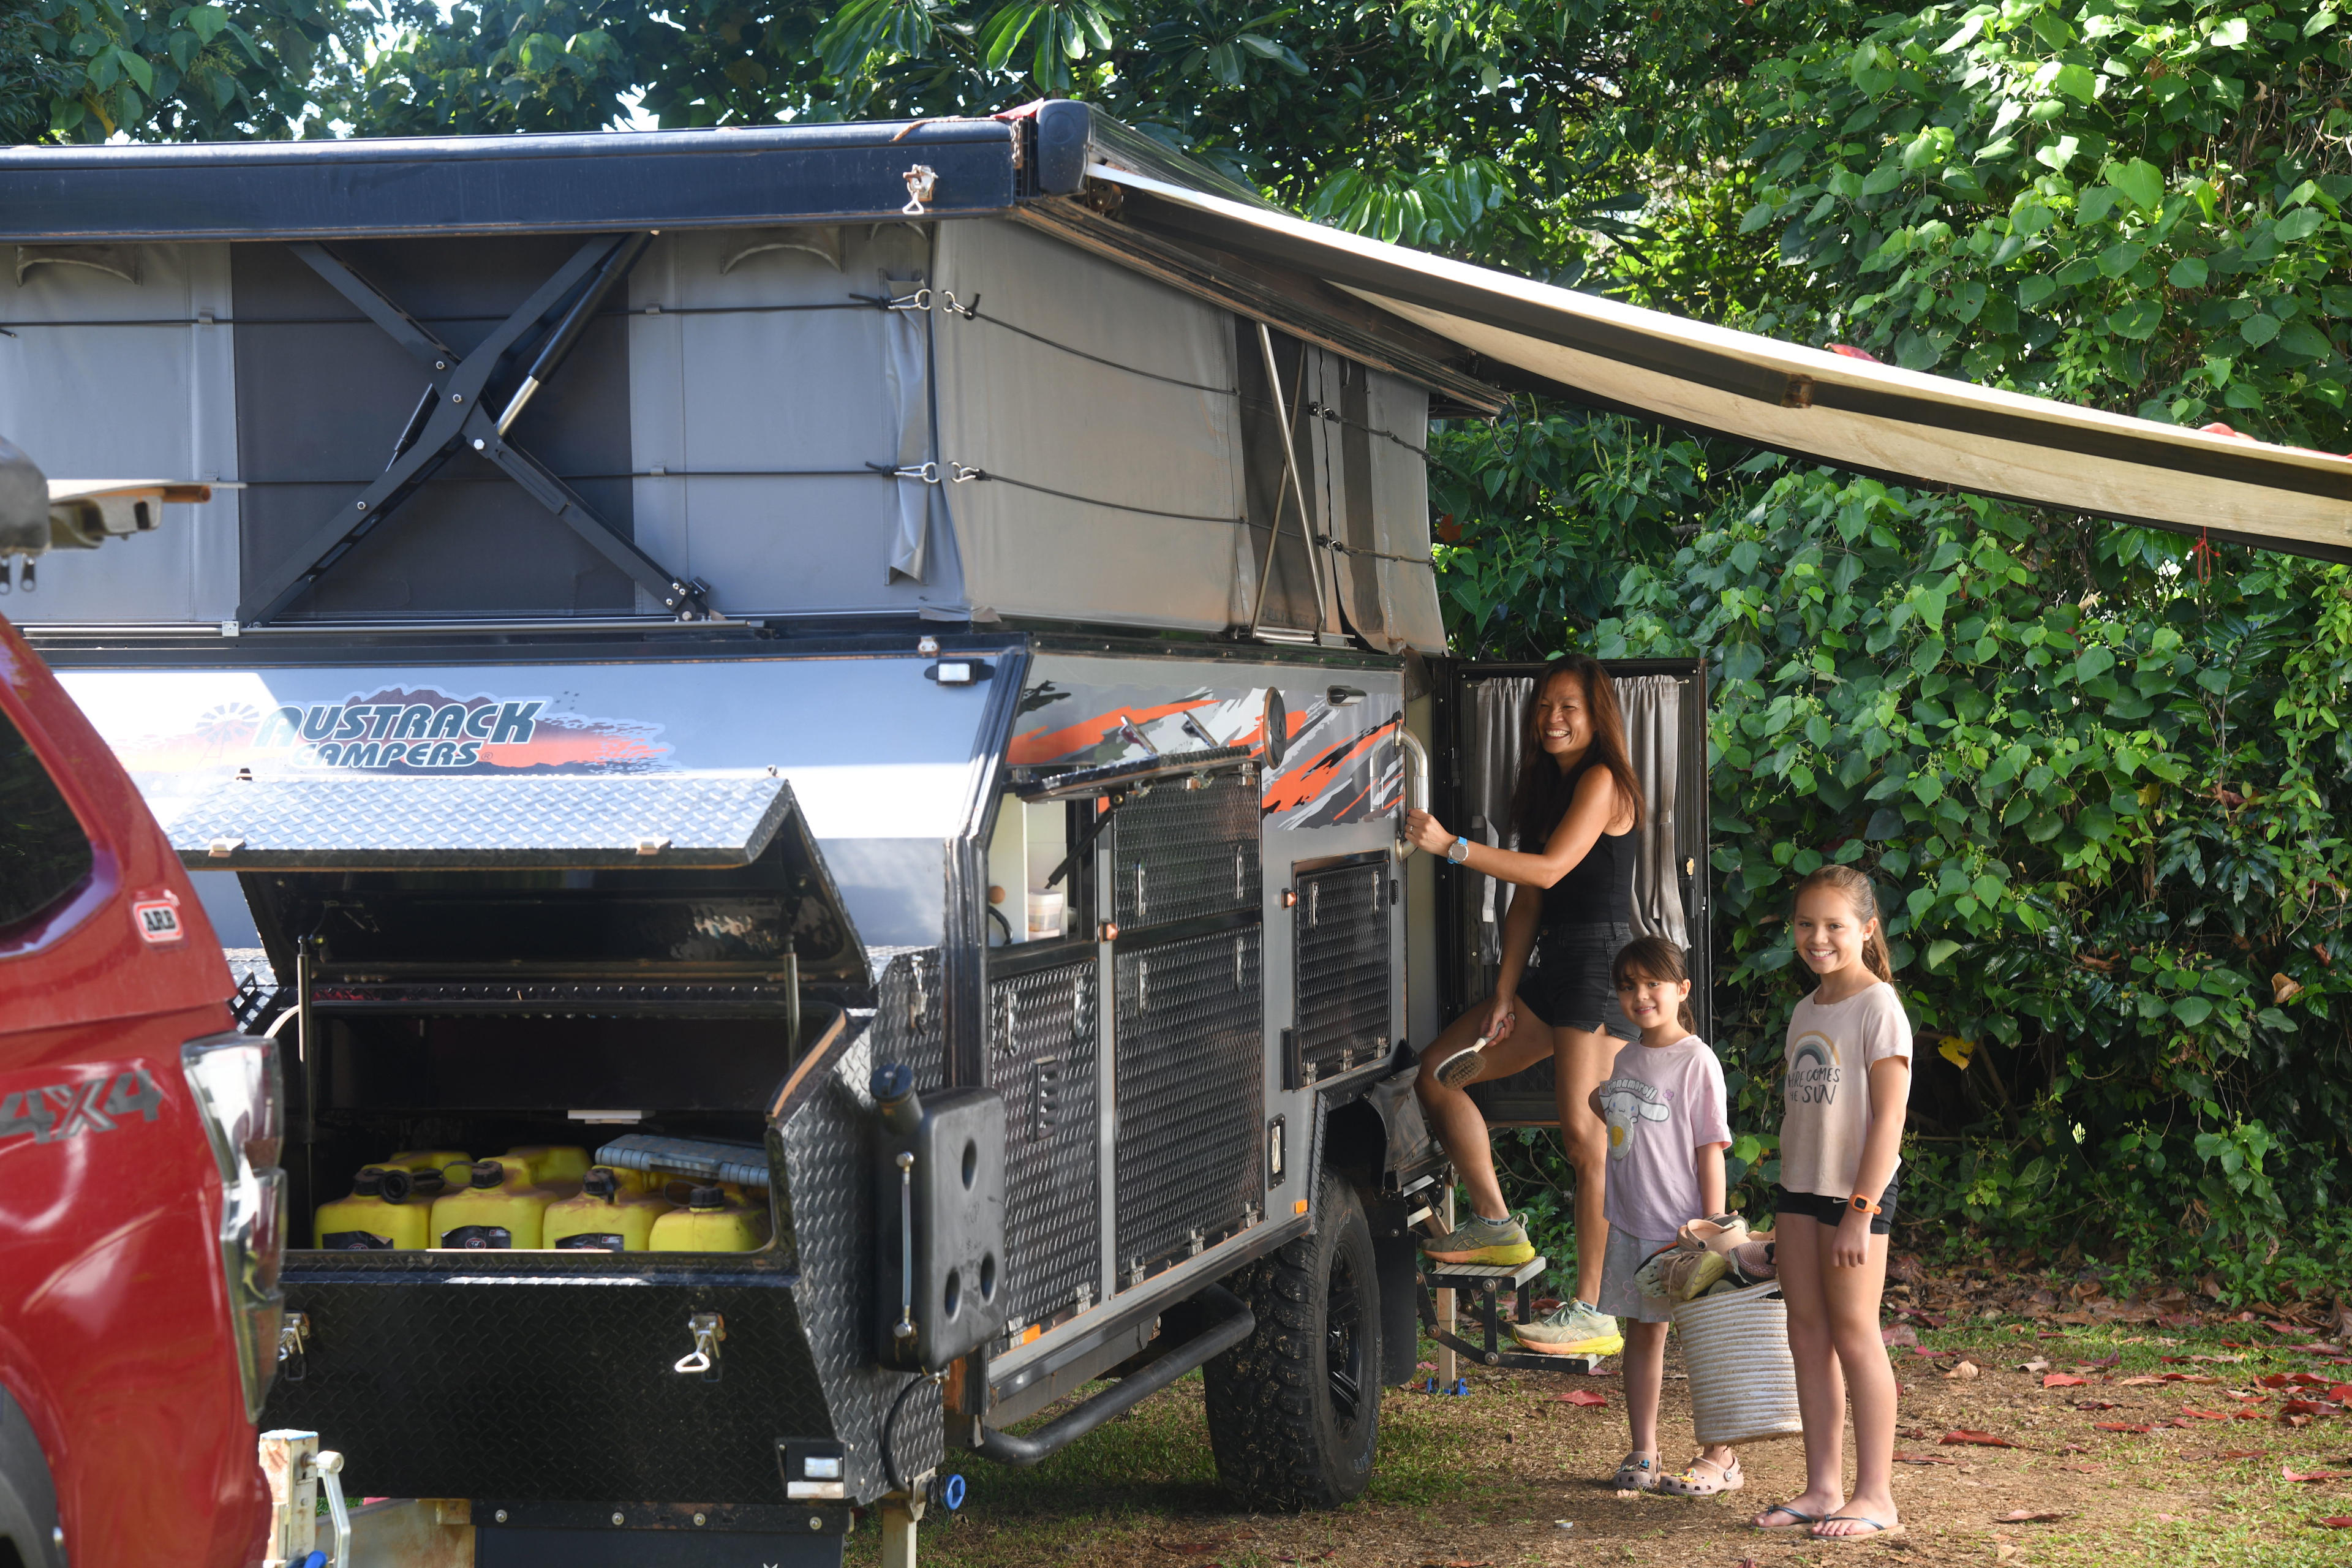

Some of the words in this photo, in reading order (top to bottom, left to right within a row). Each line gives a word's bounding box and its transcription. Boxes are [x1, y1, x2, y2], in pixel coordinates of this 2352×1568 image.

[249, 701, 546, 748] AUSTRACK
[291, 740, 484, 768] CAMPERS
[143, 910, 176, 931] ARB
[1807, 1068, 1841, 1082] COMES
[1802, 1084, 1836, 1105] SUN
